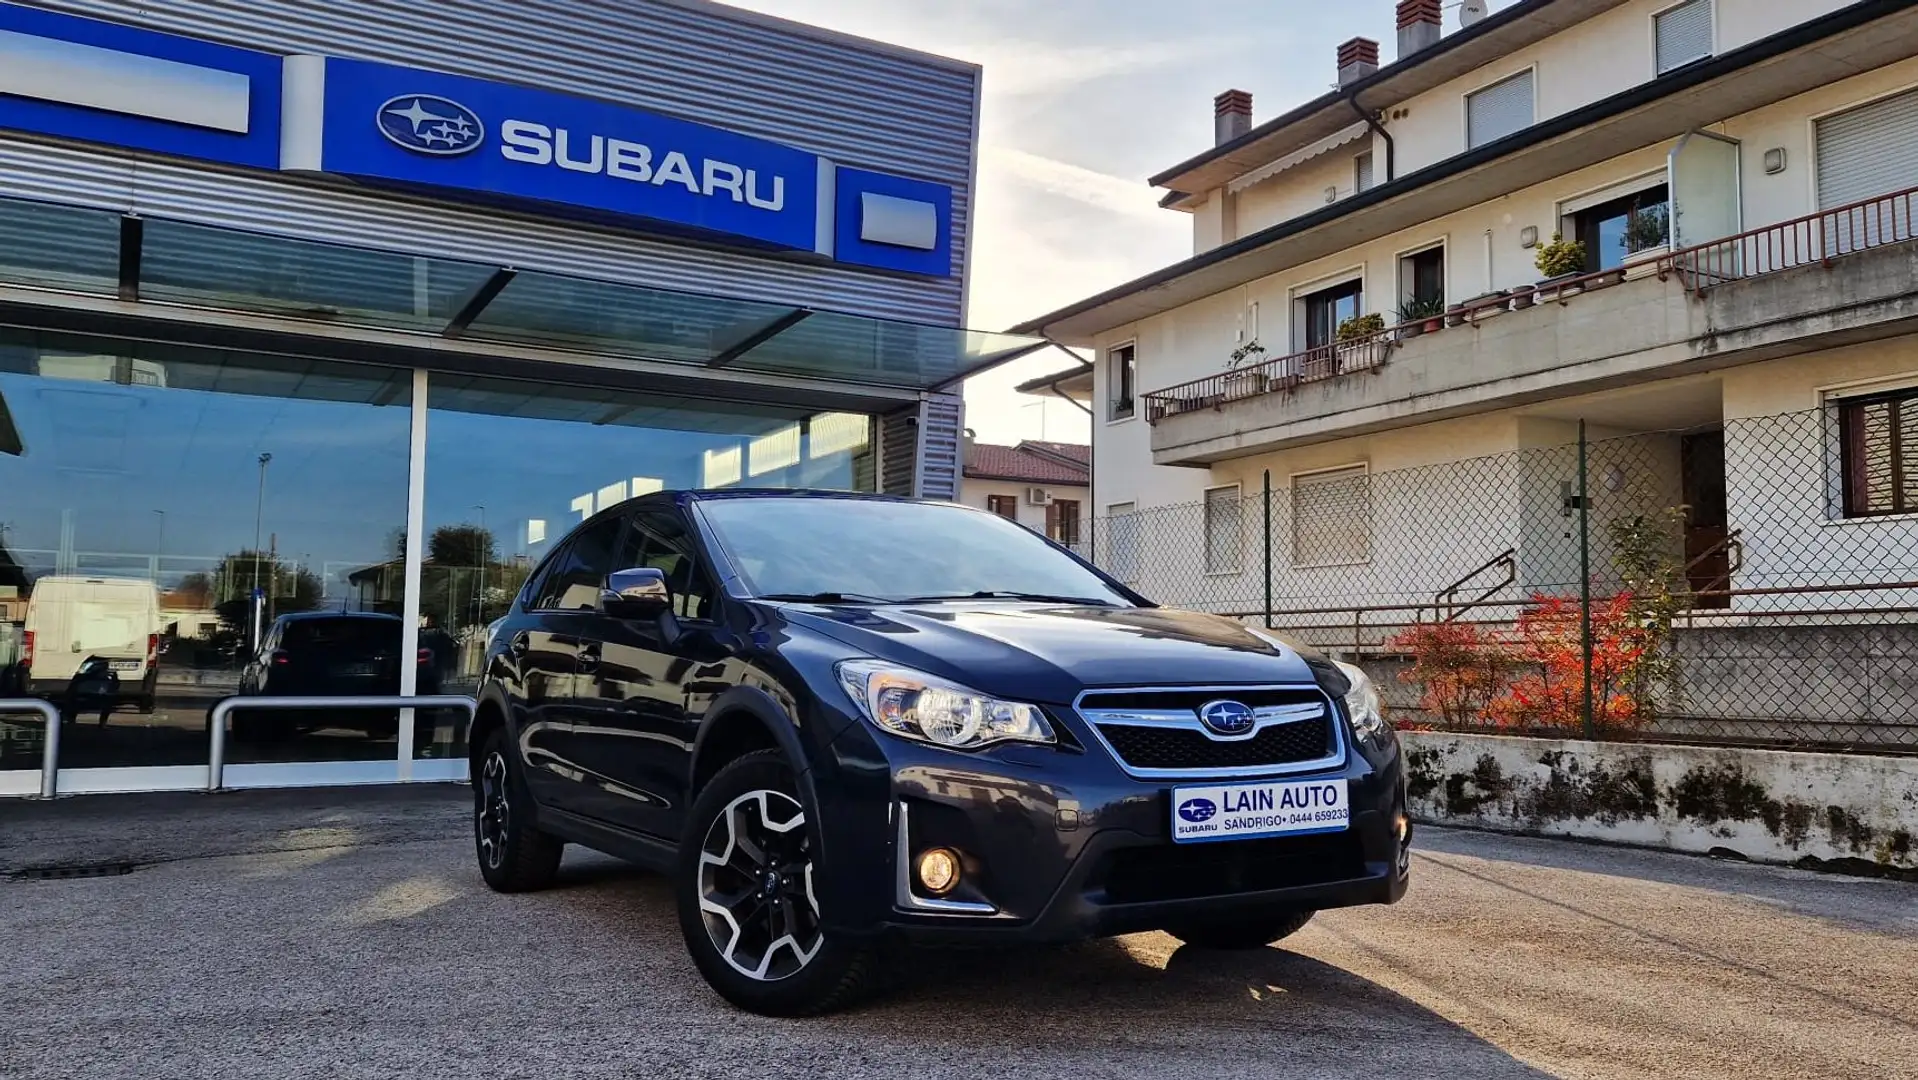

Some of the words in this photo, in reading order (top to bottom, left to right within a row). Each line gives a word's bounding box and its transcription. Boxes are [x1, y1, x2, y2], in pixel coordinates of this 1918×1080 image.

[501, 118, 785, 211] SUBARU
[1224, 788, 1273, 812] LAIN
[1280, 785, 1337, 809] AUTO
[1290, 813, 1312, 824] 0444
[1315, 808, 1348, 821] 659233
[1179, 824, 1218, 833] SUBARU
